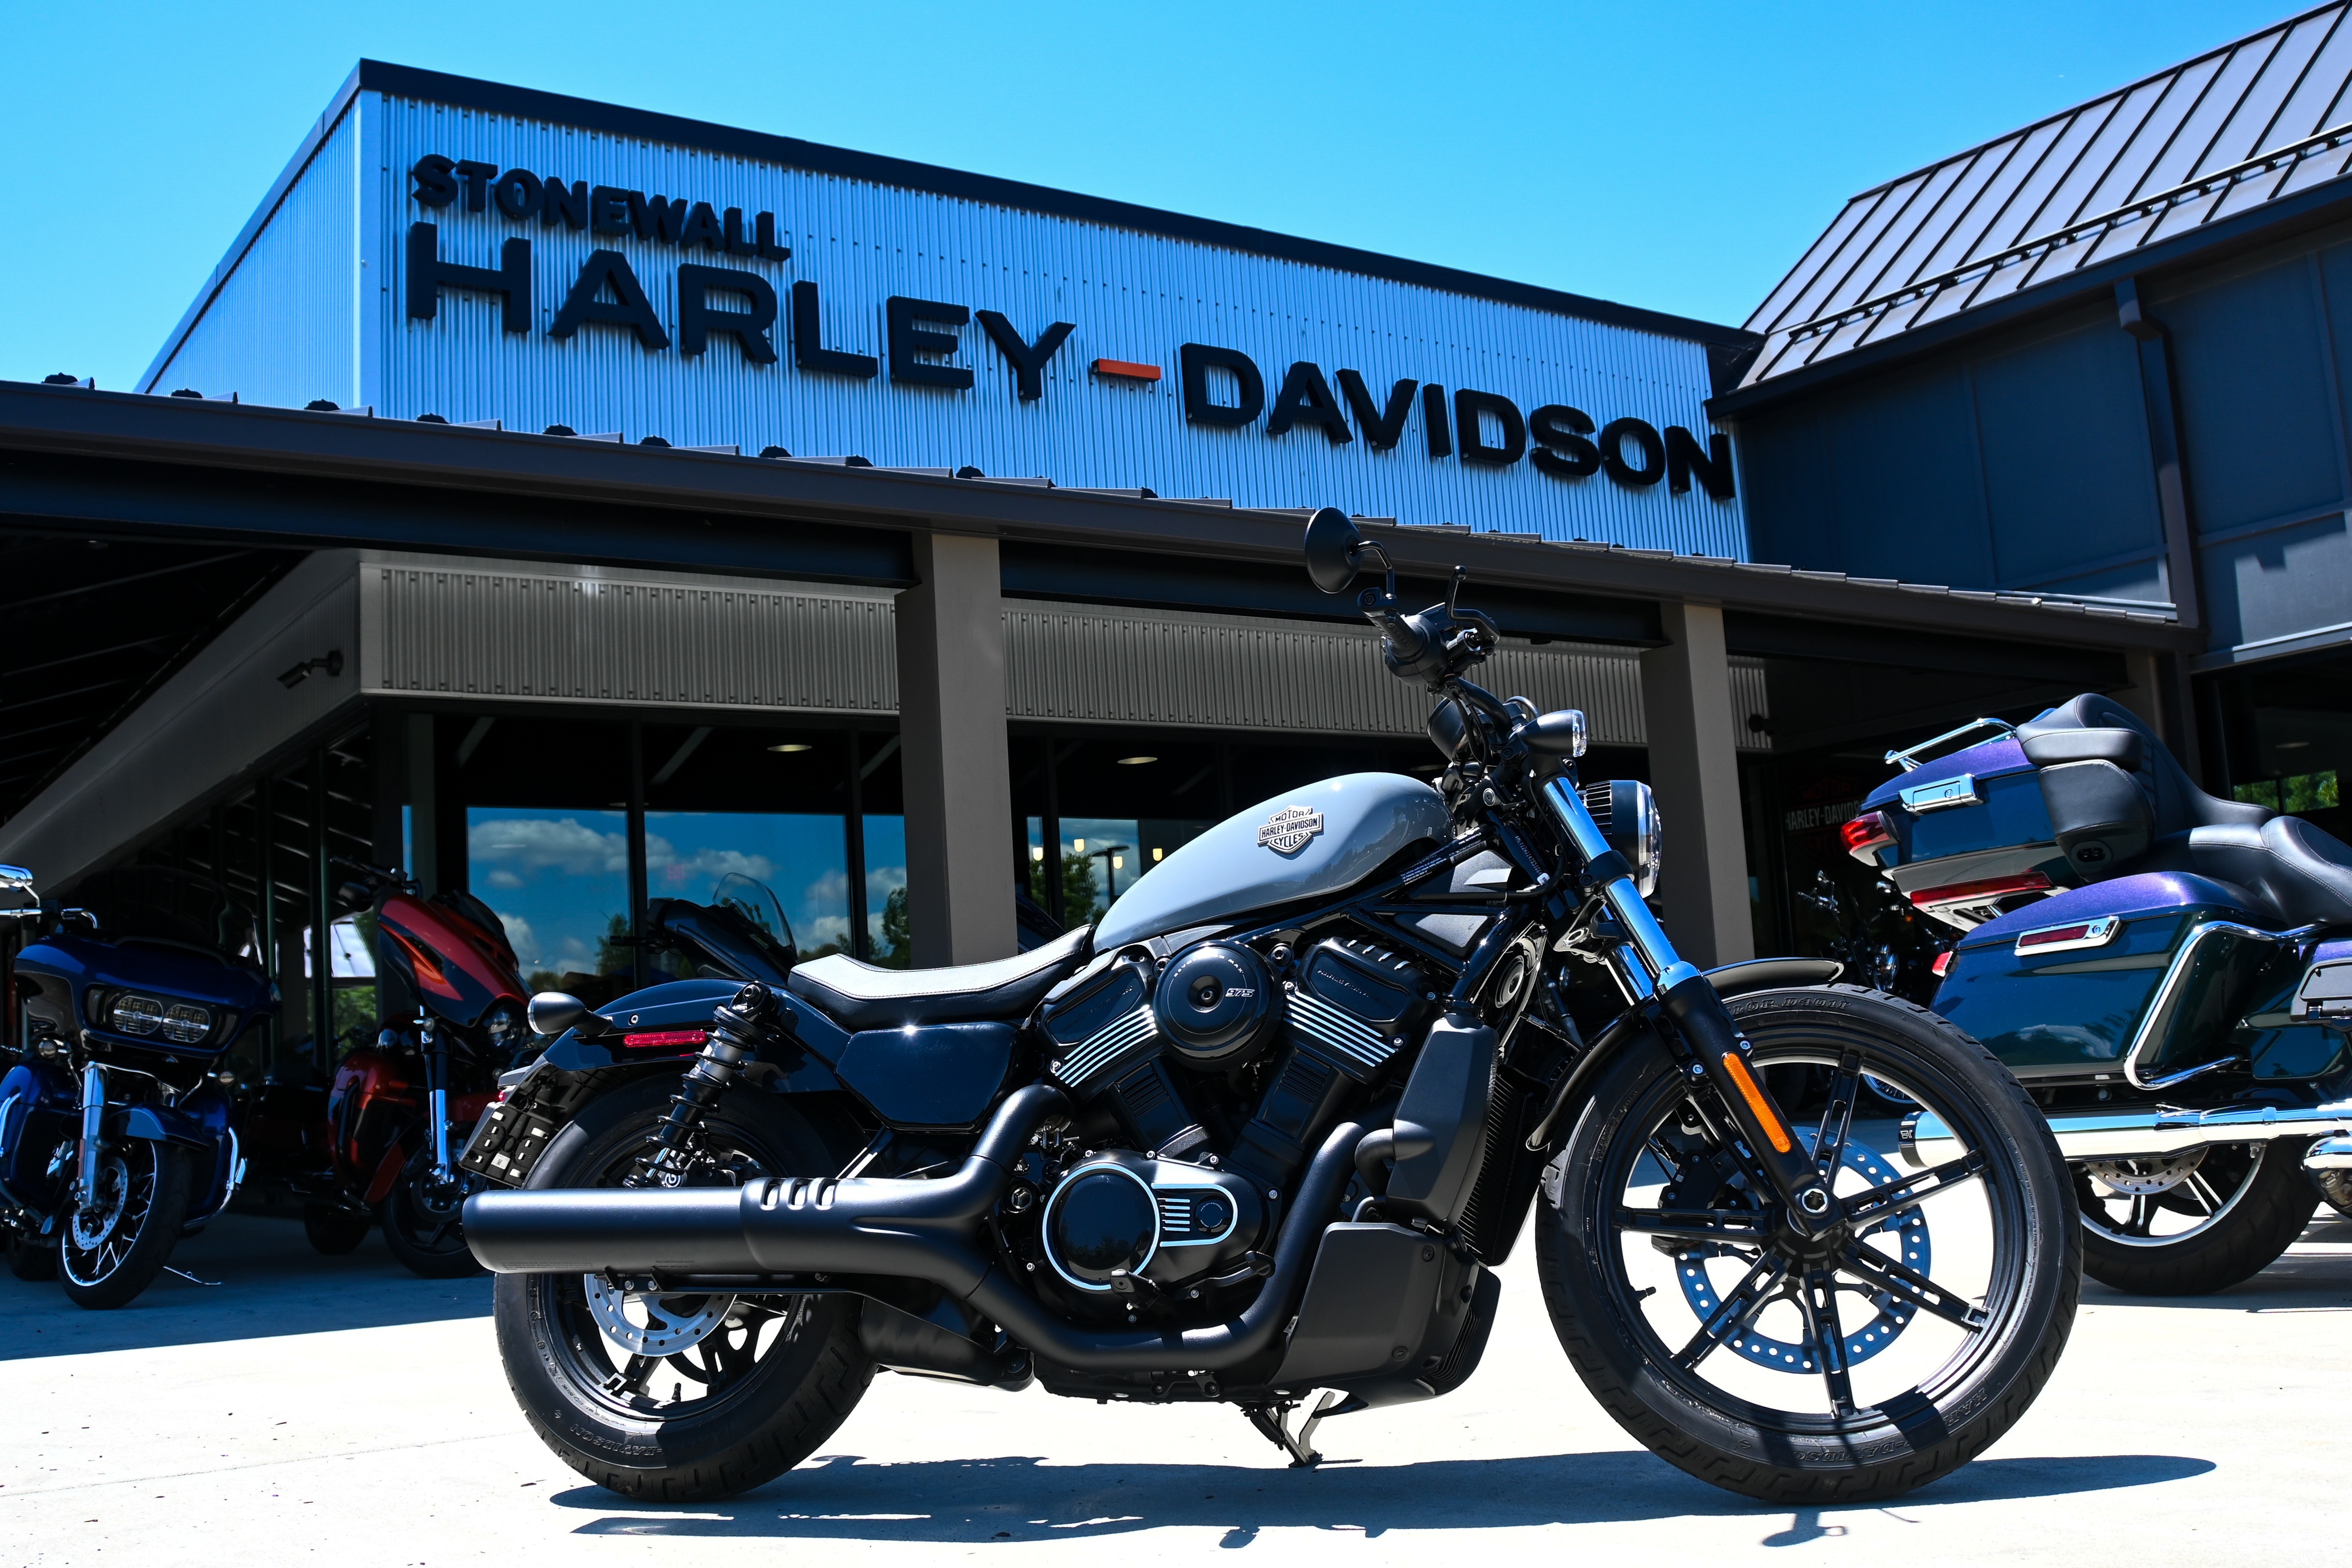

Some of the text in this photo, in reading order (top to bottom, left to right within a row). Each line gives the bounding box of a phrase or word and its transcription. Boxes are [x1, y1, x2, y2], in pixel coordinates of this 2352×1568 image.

[411, 153, 791, 262] STONEWALL
[1275, 809, 1304, 822] MOTOR
[1785, 800, 1863, 831] HARLEY-DAVIDS
[1261, 817, 1318, 839] HARLEY-DAVIDSON
[1274, 832, 1305, 847] CYCLES
[1225, 988, 1256, 998] 975
[1726, 998, 1776, 1016] LOP
